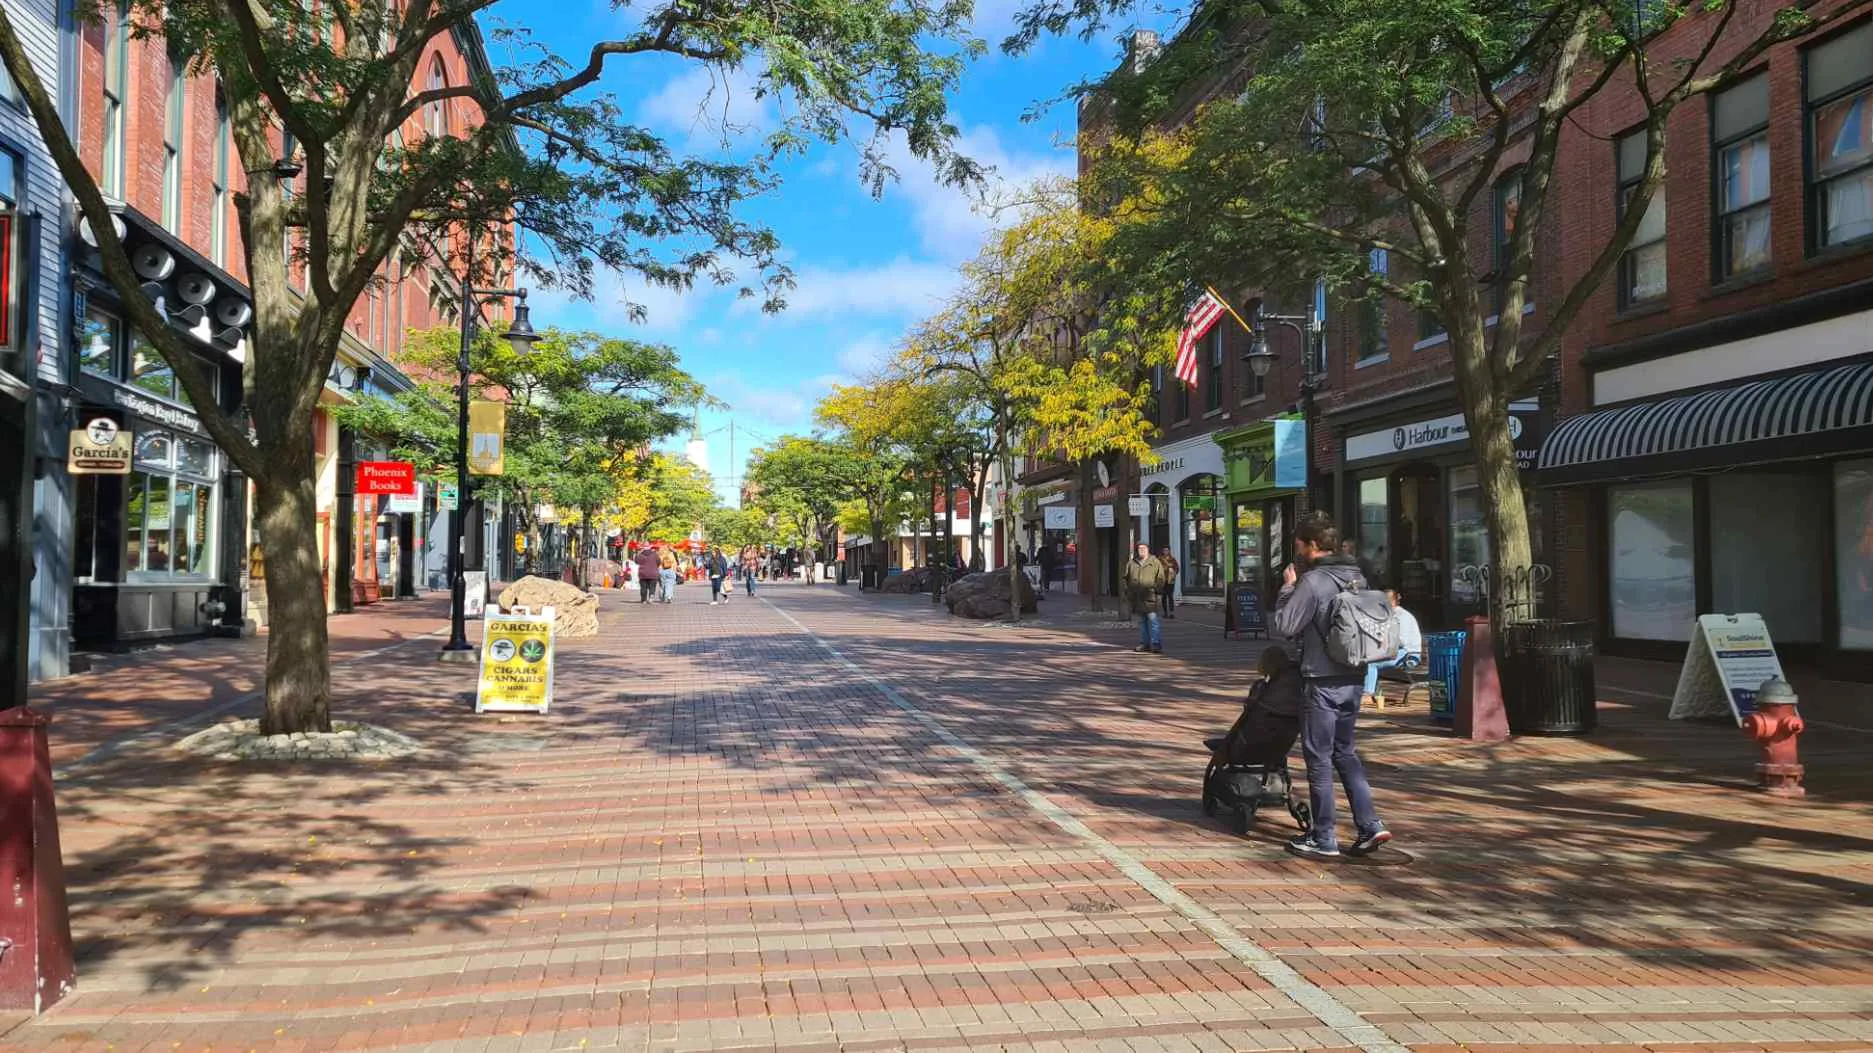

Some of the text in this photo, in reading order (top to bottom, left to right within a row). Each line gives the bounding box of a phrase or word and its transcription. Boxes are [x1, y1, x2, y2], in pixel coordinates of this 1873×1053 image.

[1408, 424, 1449, 445] Harbour
[72, 446, 129, 459] Garcia's
[364, 466, 407, 477] Phoenix
[370, 480, 401, 490] Books
[494, 667, 538, 675] CIGARS
[487, 675, 544, 683] CANNABIS
